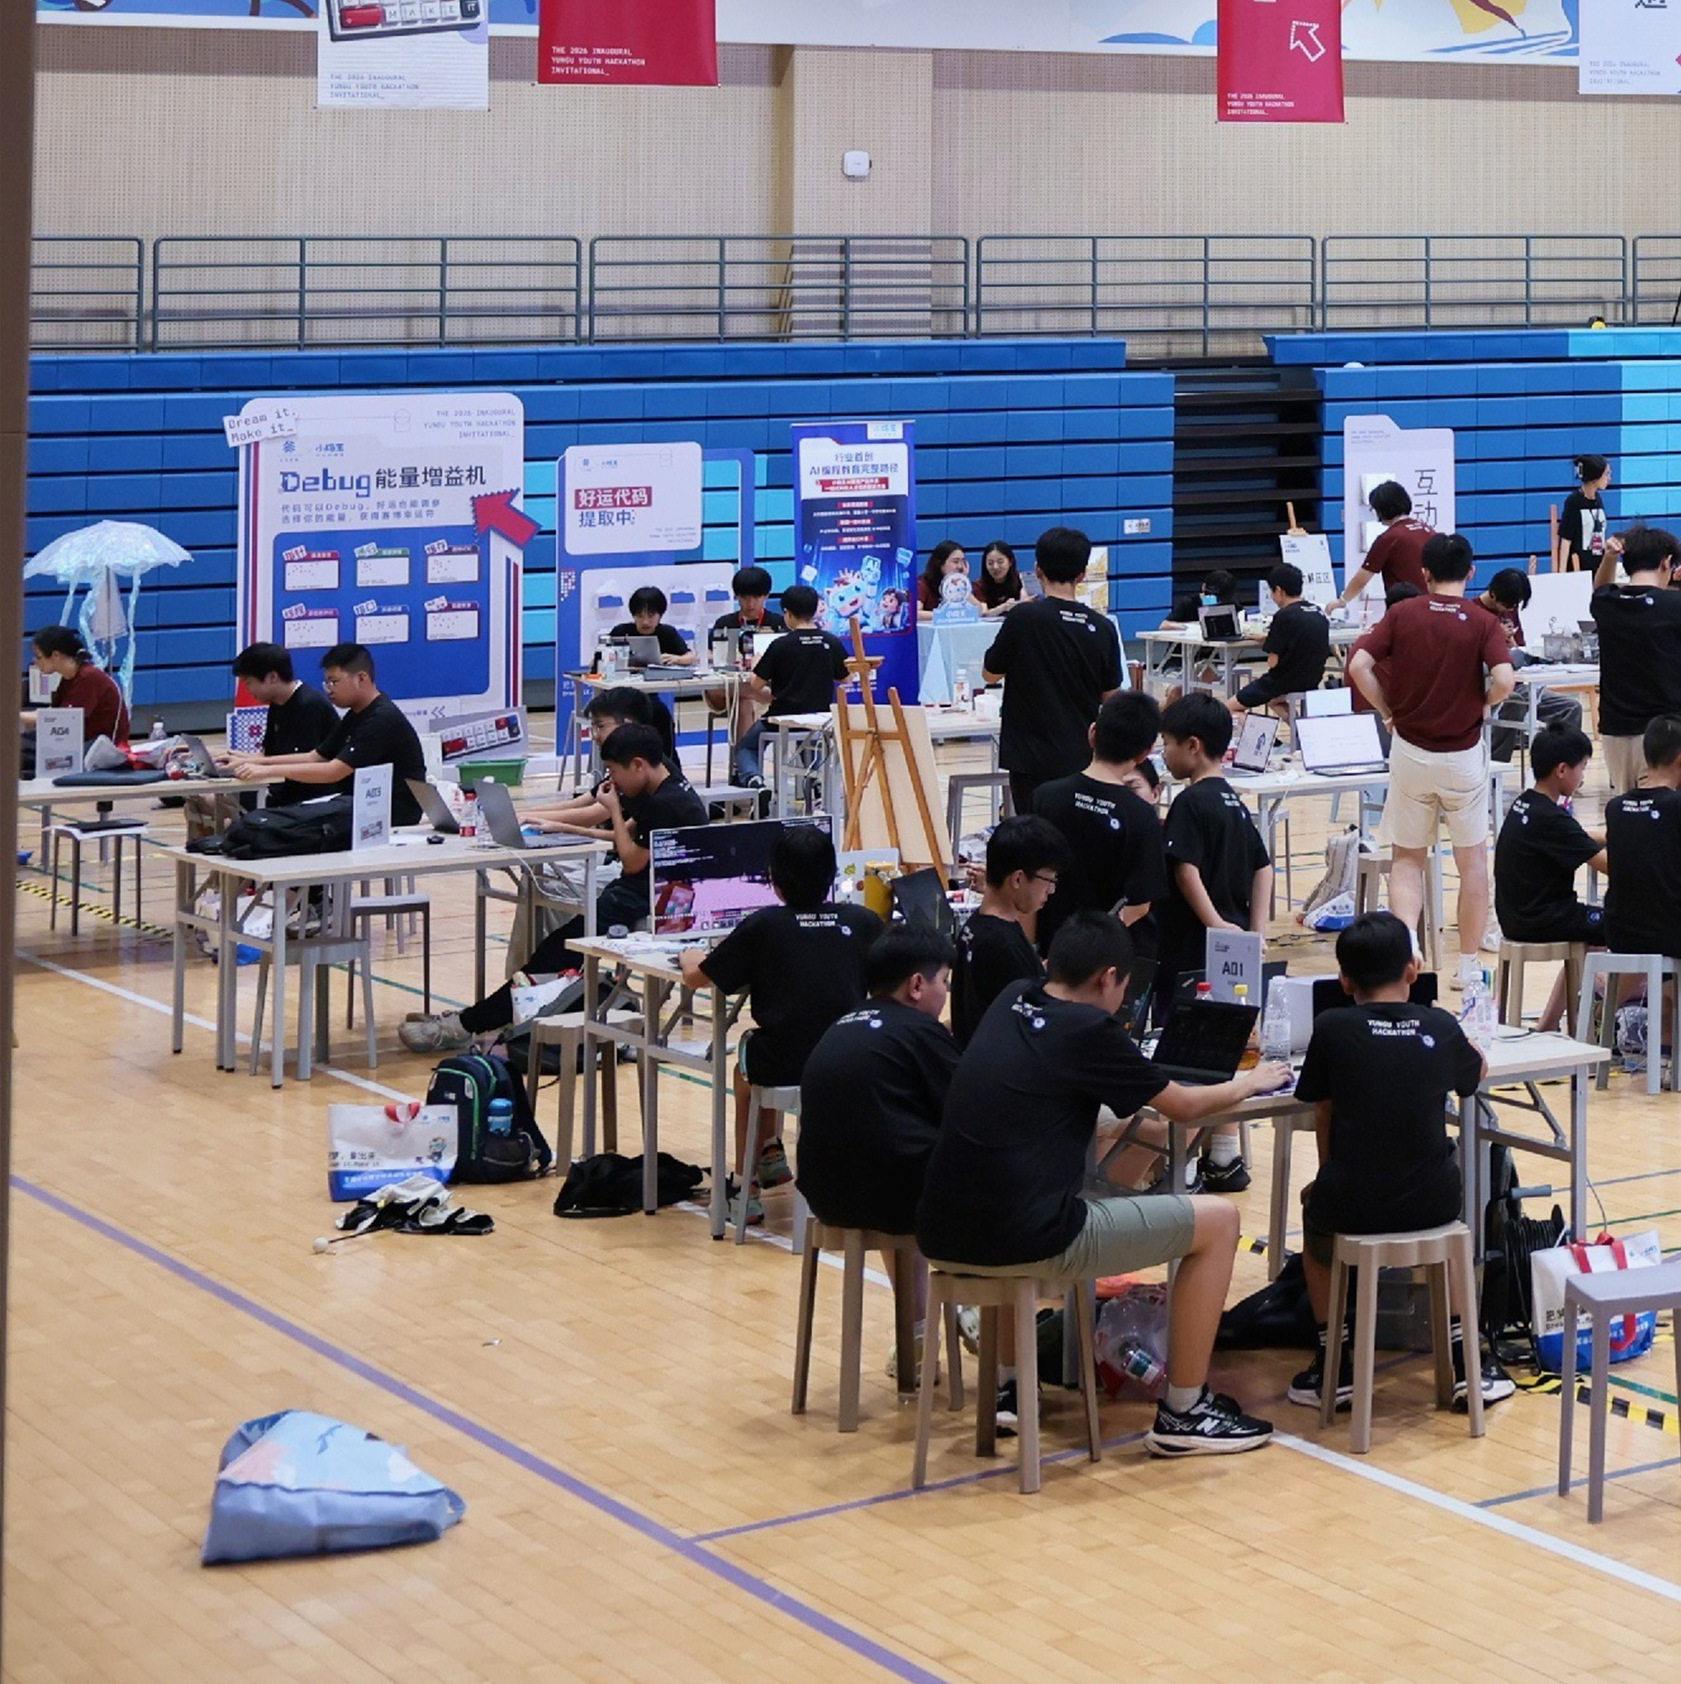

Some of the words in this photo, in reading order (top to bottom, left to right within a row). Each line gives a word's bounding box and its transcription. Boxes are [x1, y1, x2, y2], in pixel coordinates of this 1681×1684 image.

[228, 413, 268, 430] Dream
[230, 428, 263, 443] Make
[281, 469, 371, 498] Debug
[375, 466, 487, 490] 能量增益机
[577, 488, 648, 507] 好运代码
[1222, 961, 1244, 977] A01
